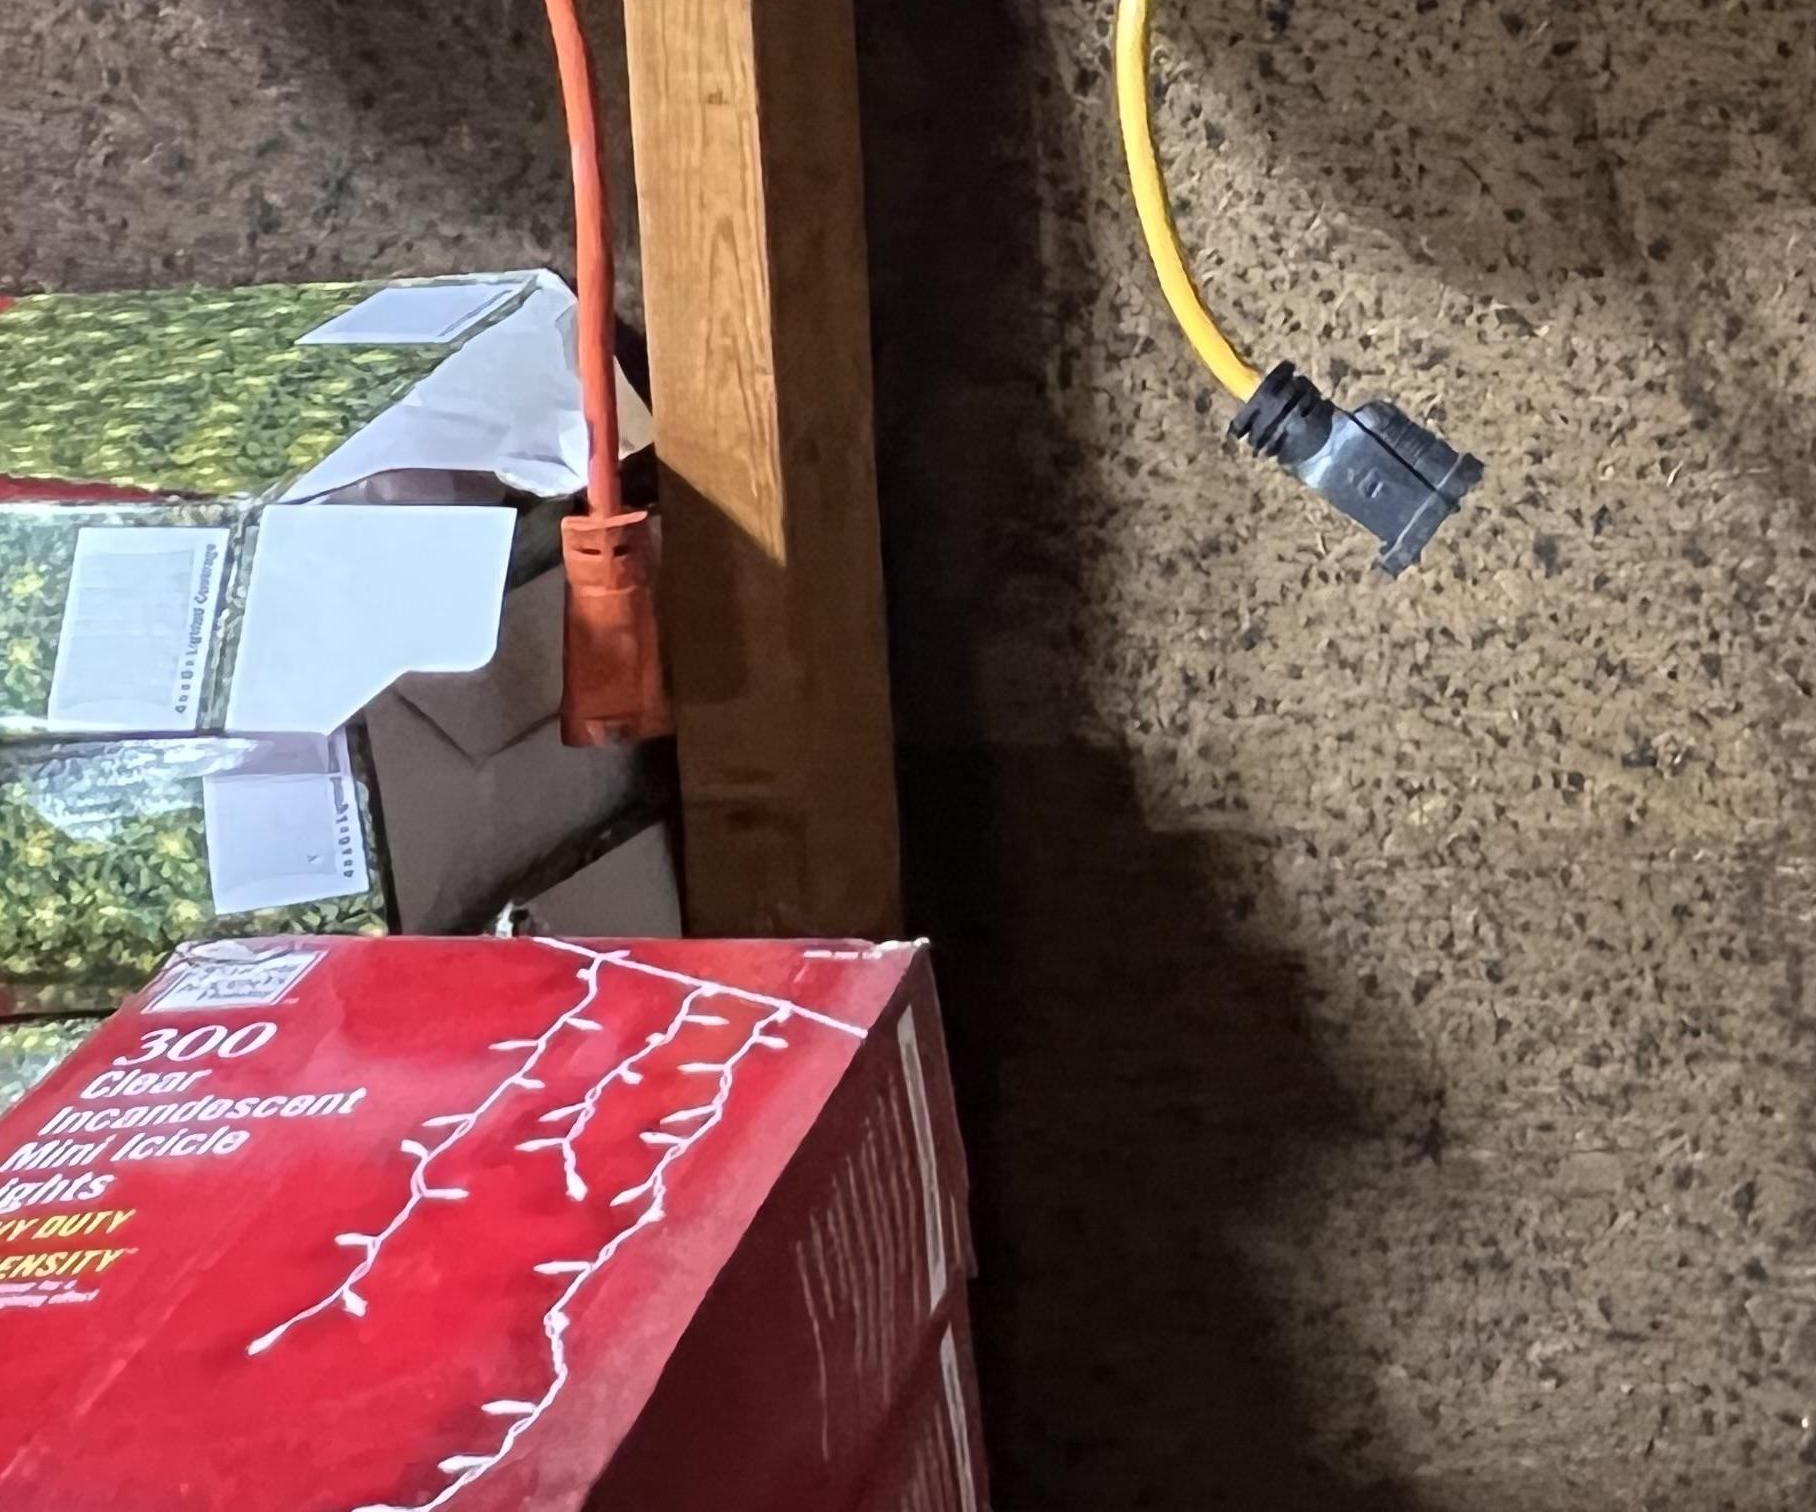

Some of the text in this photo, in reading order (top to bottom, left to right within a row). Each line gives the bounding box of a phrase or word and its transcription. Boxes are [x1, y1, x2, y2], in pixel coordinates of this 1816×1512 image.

[112, 1022, 278, 1066] 300
[80, 1069, 213, 1100] Clear
[37, 1087, 367, 1137] Incandescent
[0, 1125, 251, 1172] Mini Icicle
[31, 1209, 137, 1240] DUTY
